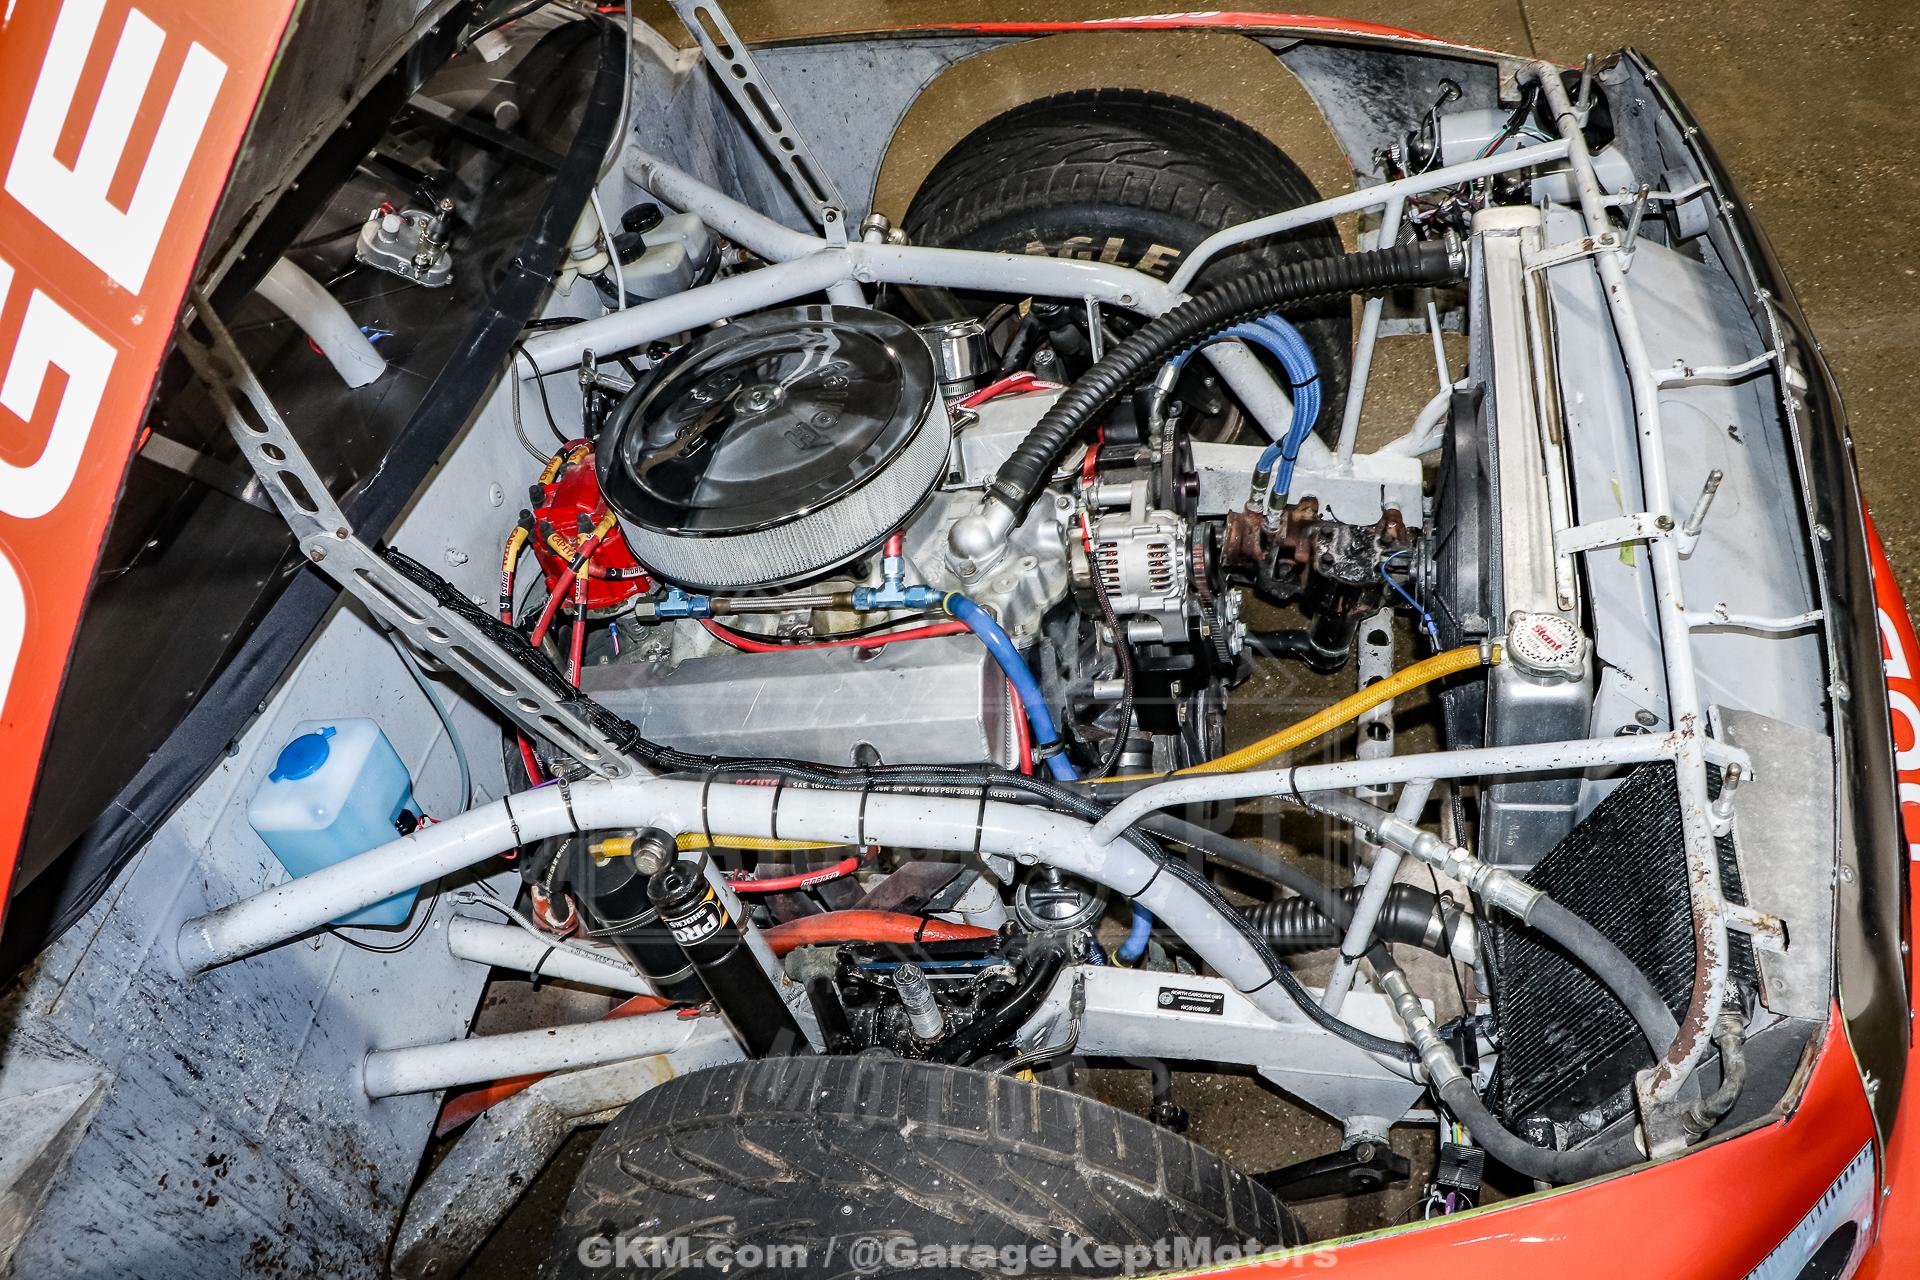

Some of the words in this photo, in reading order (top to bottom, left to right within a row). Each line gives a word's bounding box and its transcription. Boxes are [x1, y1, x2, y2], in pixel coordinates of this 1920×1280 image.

[921, 786, 939, 794] 4785
[989, 791, 1017, 799] 1Q2013
[667, 907, 707, 929] SHOCKS
[671, 910, 719, 943] PRO
